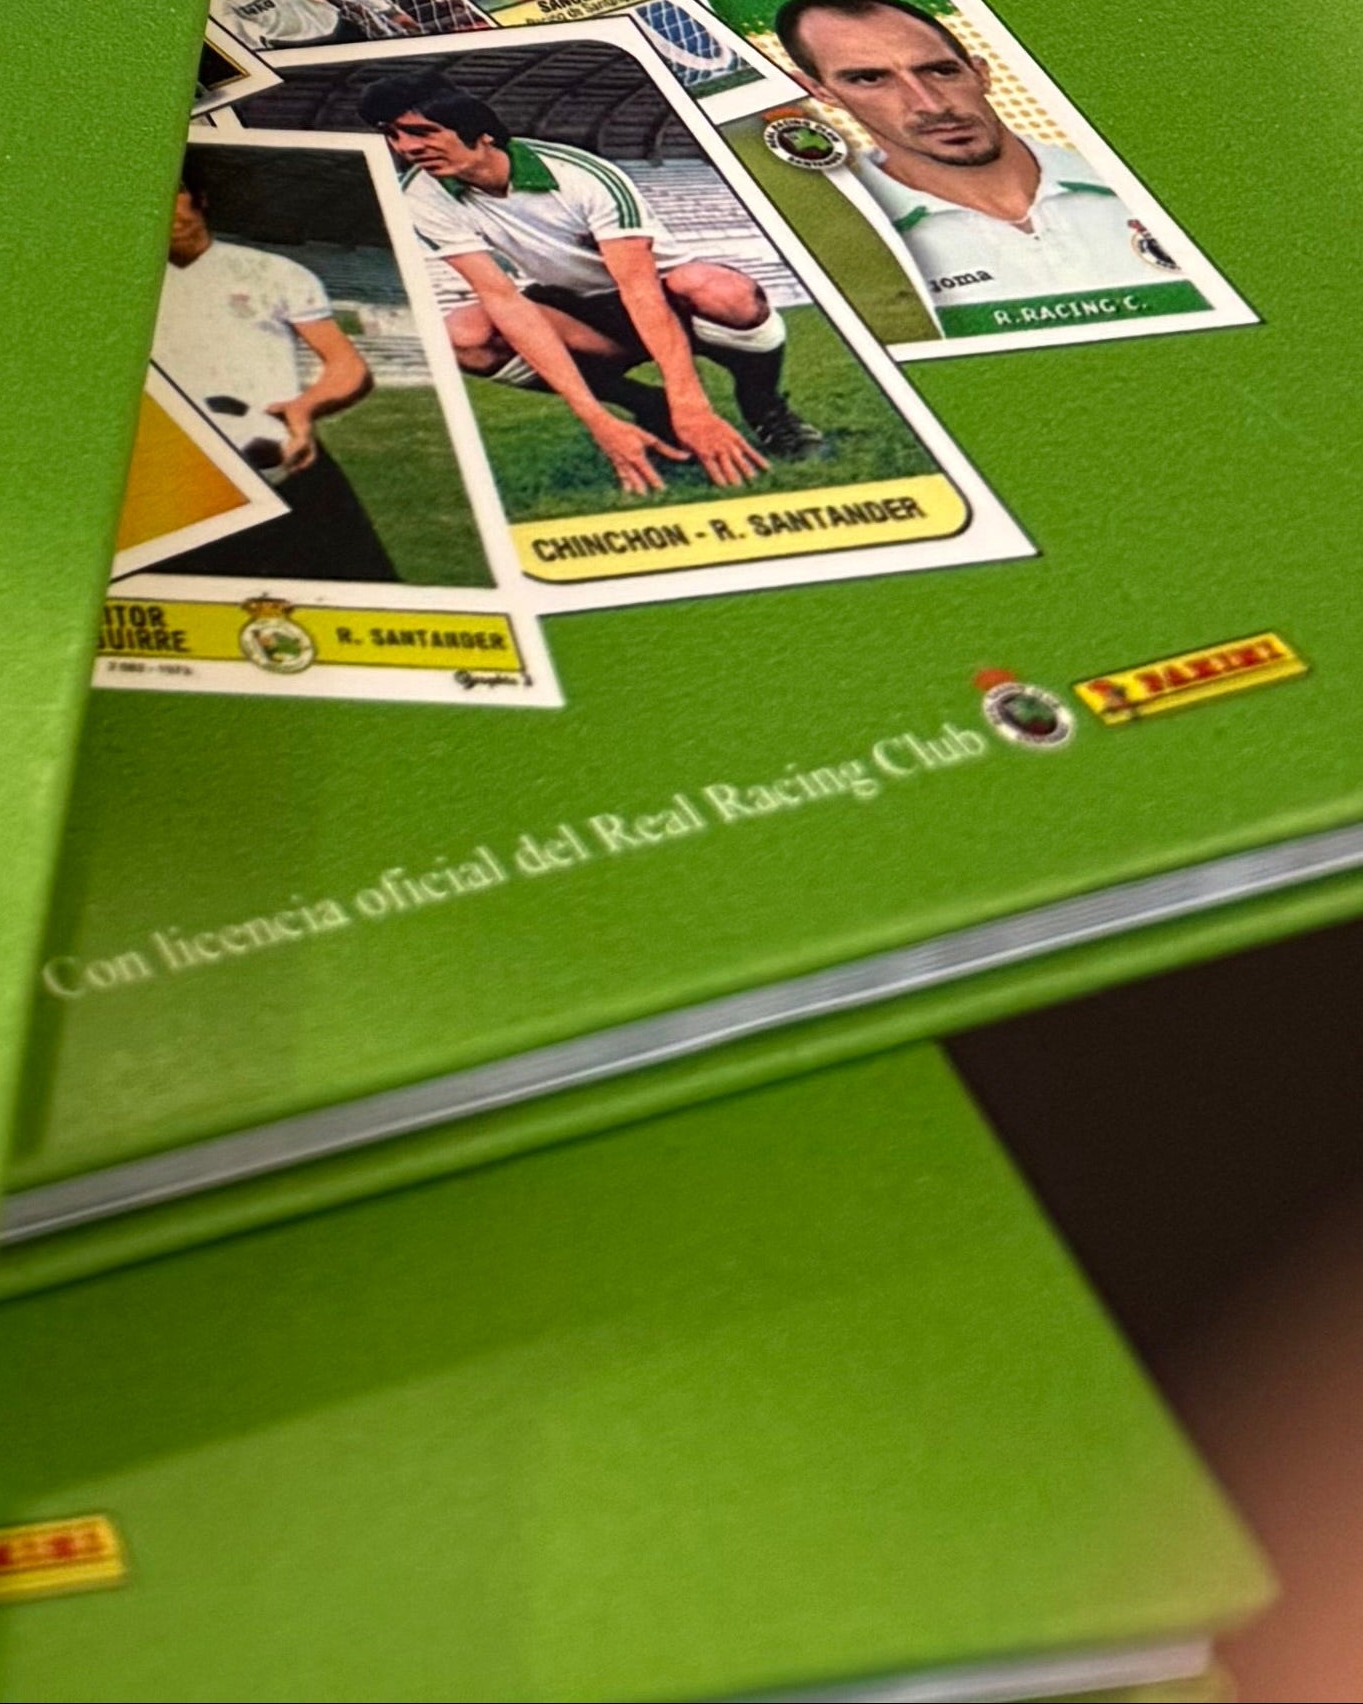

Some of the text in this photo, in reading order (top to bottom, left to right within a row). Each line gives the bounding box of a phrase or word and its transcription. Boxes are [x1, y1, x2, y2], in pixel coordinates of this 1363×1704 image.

[530, 494, 927, 564] CHINCHON R. SANTANDER
[104, 604, 166, 629] ITOR
[337, 626, 509, 652] R. SANTANDER
[42, 722, 986, 1000] Con licencia oficial del Real Racing Club
